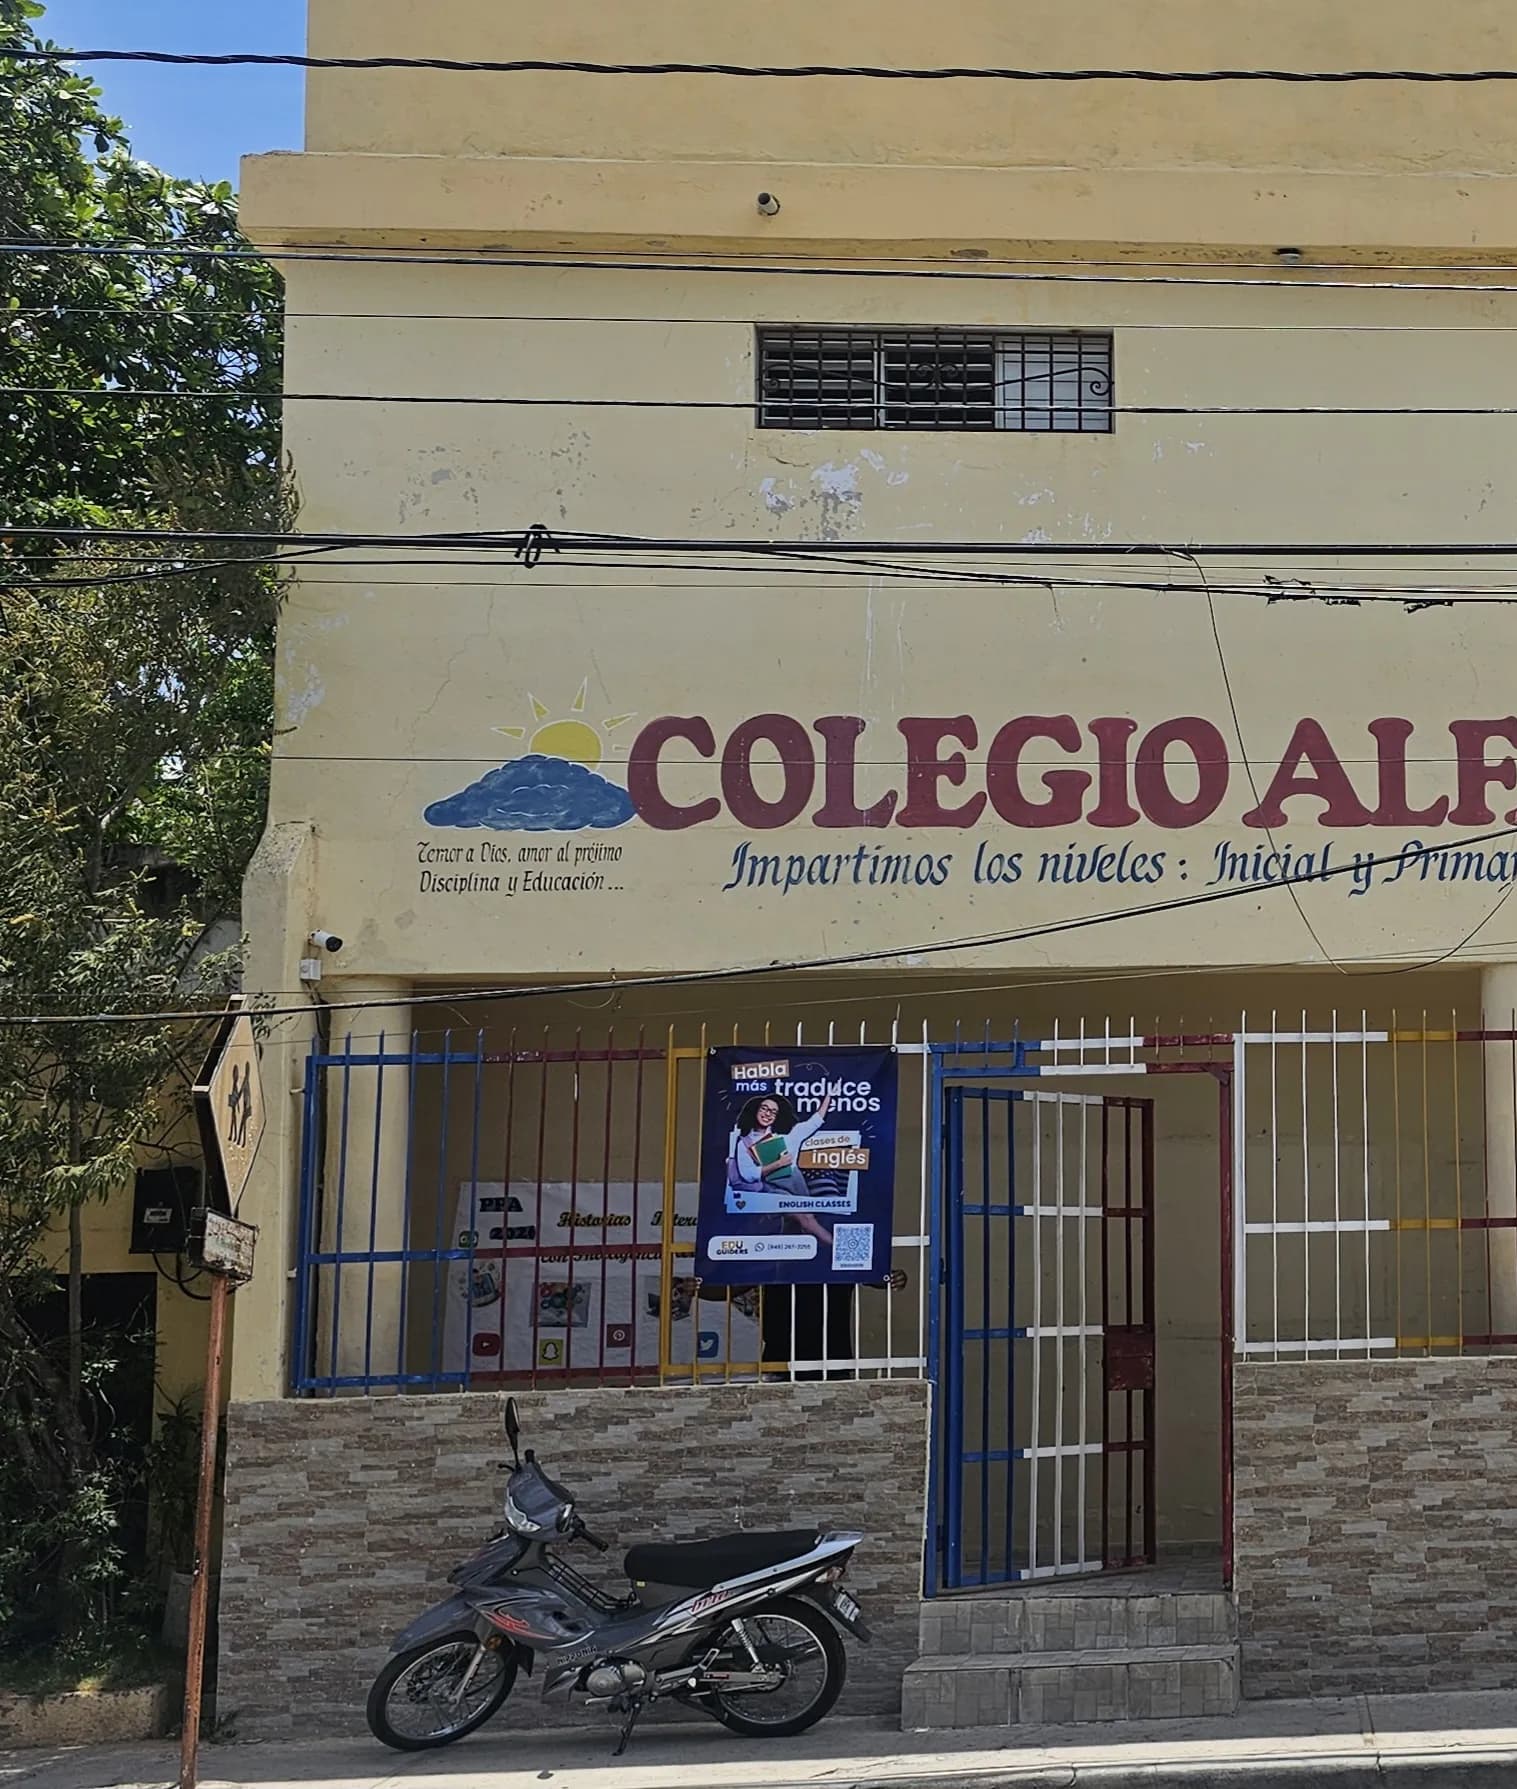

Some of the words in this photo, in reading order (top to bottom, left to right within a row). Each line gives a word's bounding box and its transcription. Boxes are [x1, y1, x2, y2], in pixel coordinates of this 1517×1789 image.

[627, 713, 1229, 829] COLEGIO
[466, 846, 474, 862] a
[518, 846, 552, 862] amor
[557, 840, 571, 862] al
[722, 841, 953, 896] Impartimos
[974, 840, 1023, 884] los
[1205, 841, 1335, 886] Inicial
[1348, 850, 1374, 898] y
[420, 870, 500, 895] Disciplina
[505, 876, 518, 897] y
[734, 1062, 786, 1079] Habla
[735, 1080, 767, 1091] más
[774, 1077, 872, 1097] traduce
[797, 1097, 881, 1113] menos
[805, 1137, 836, 1147] clases
[837, 1135, 850, 1143] de
[812, 1149, 866, 1168] inglés
[779, 1201, 814, 1209] ENGLISH
[815, 1200, 852, 1208] CLASSES
[557, 1211, 632, 1228] Historias
